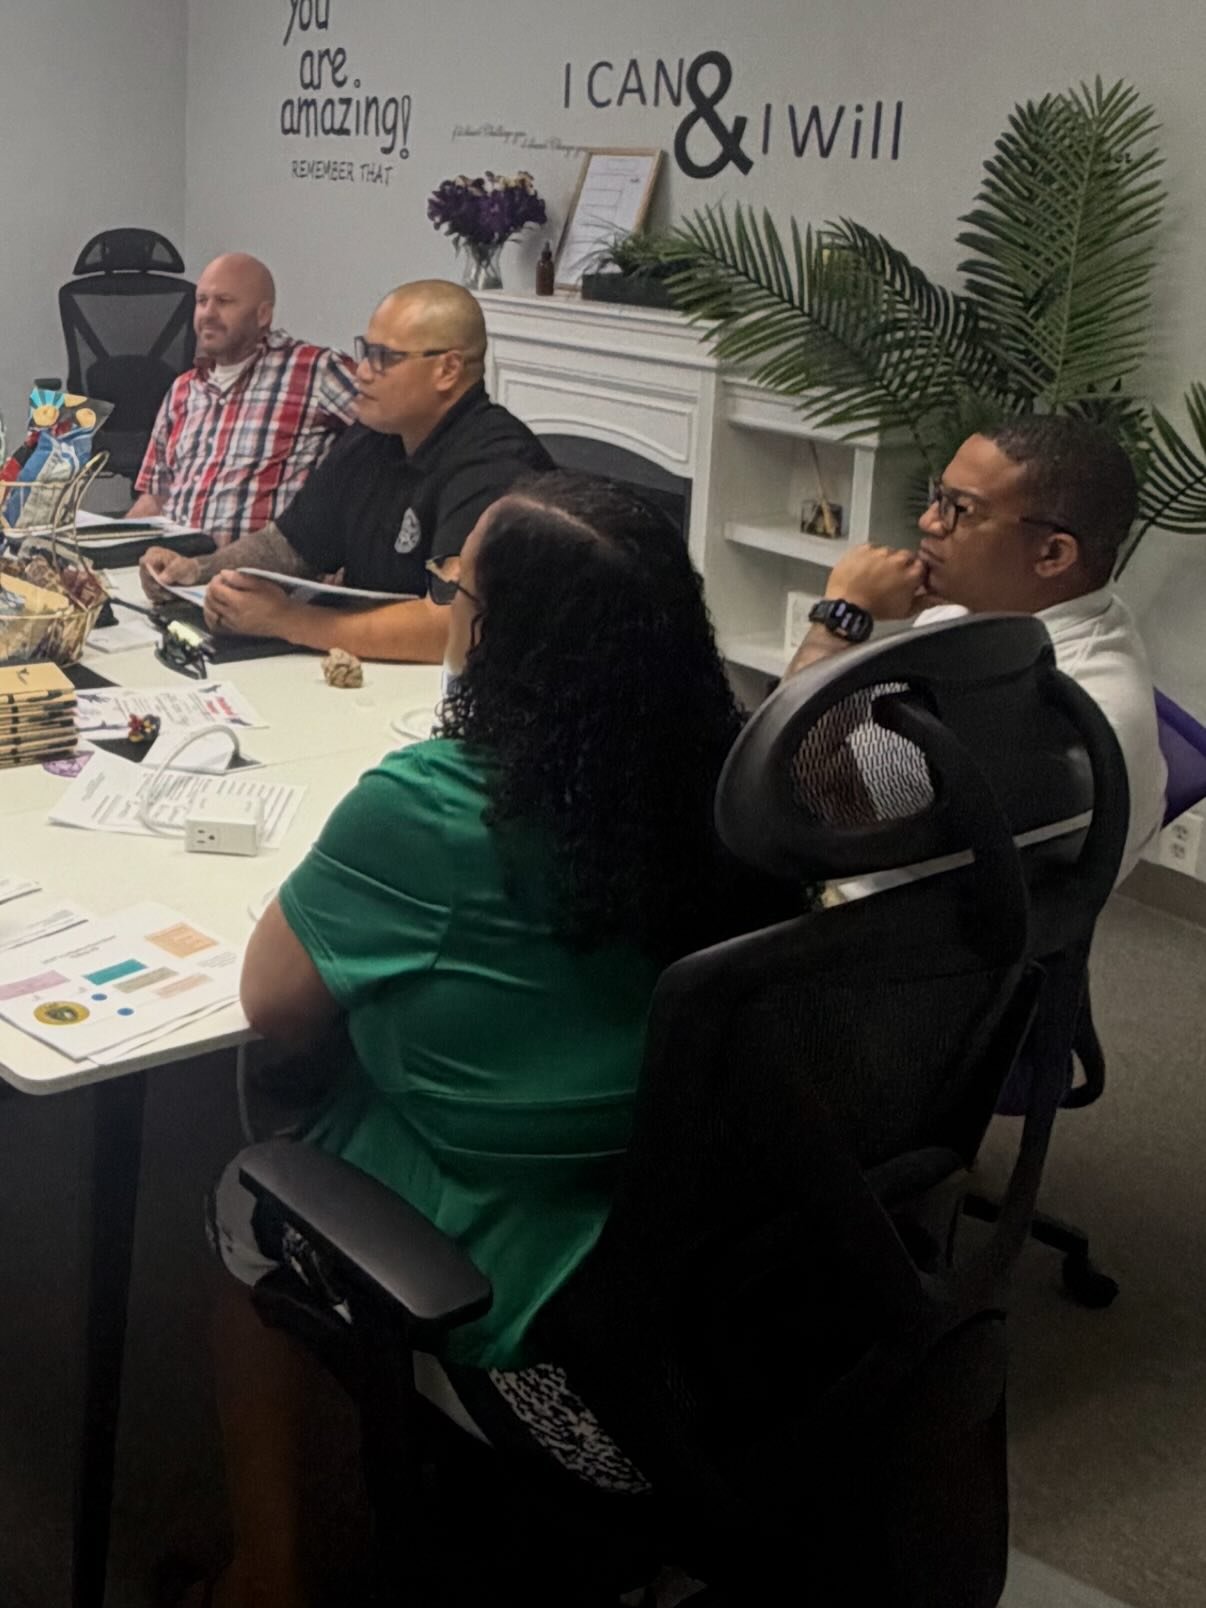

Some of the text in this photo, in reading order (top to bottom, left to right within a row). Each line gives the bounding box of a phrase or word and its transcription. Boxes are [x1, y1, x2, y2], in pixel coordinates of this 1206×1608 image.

[283, 0, 330, 47] you
[280, 95, 412, 160] amazing!
[564, 50, 903, 179] I CAN & I Will
[292, 160, 393, 186] REMEMBER THAT
